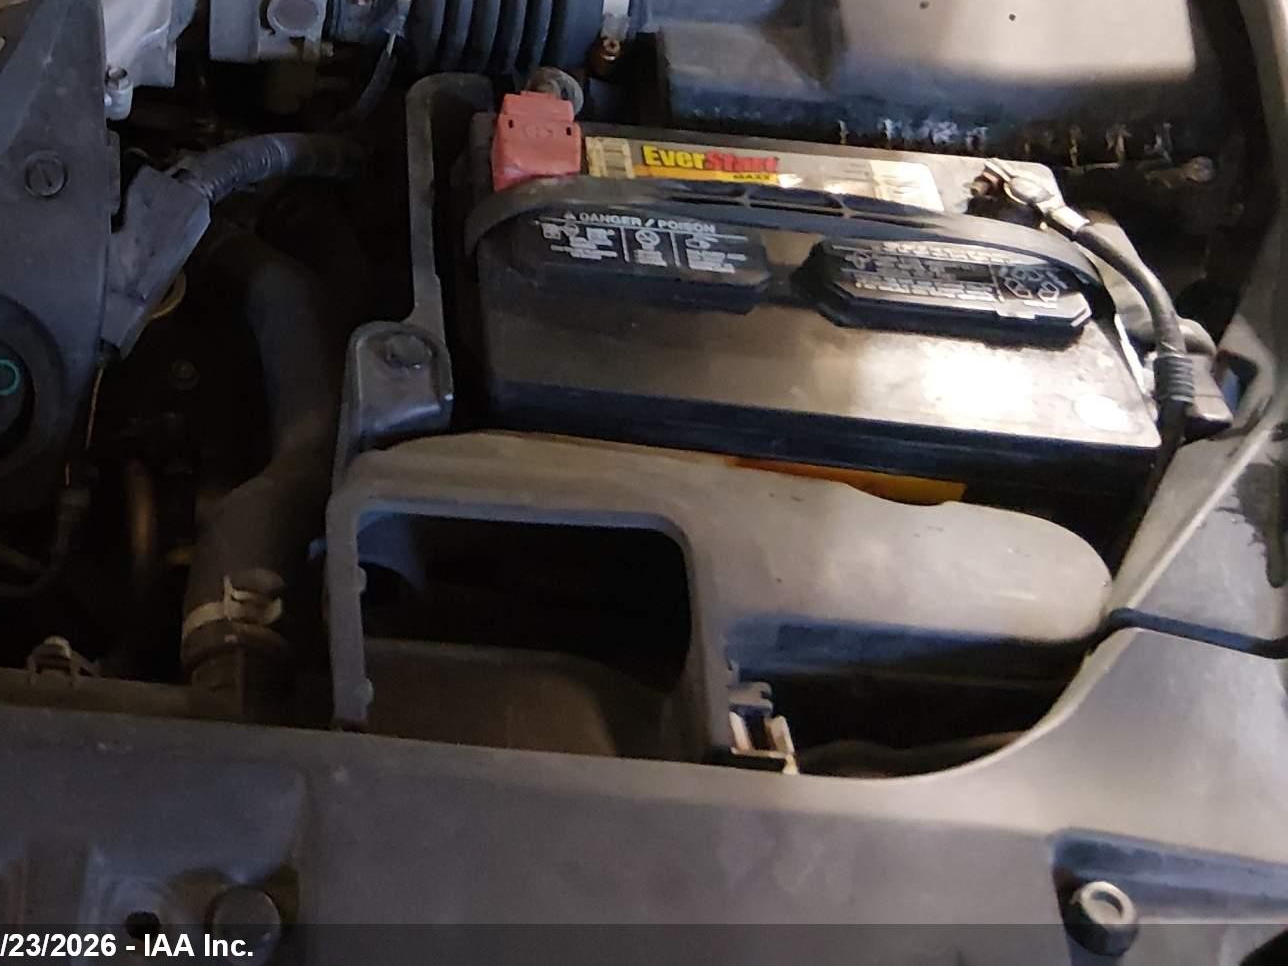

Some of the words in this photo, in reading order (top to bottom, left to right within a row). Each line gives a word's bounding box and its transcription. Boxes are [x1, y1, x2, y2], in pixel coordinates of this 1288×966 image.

[641, 144, 778, 173] EverStart
[579, 212, 642, 227] DANGER
[657, 219, 716, 234] POISON
